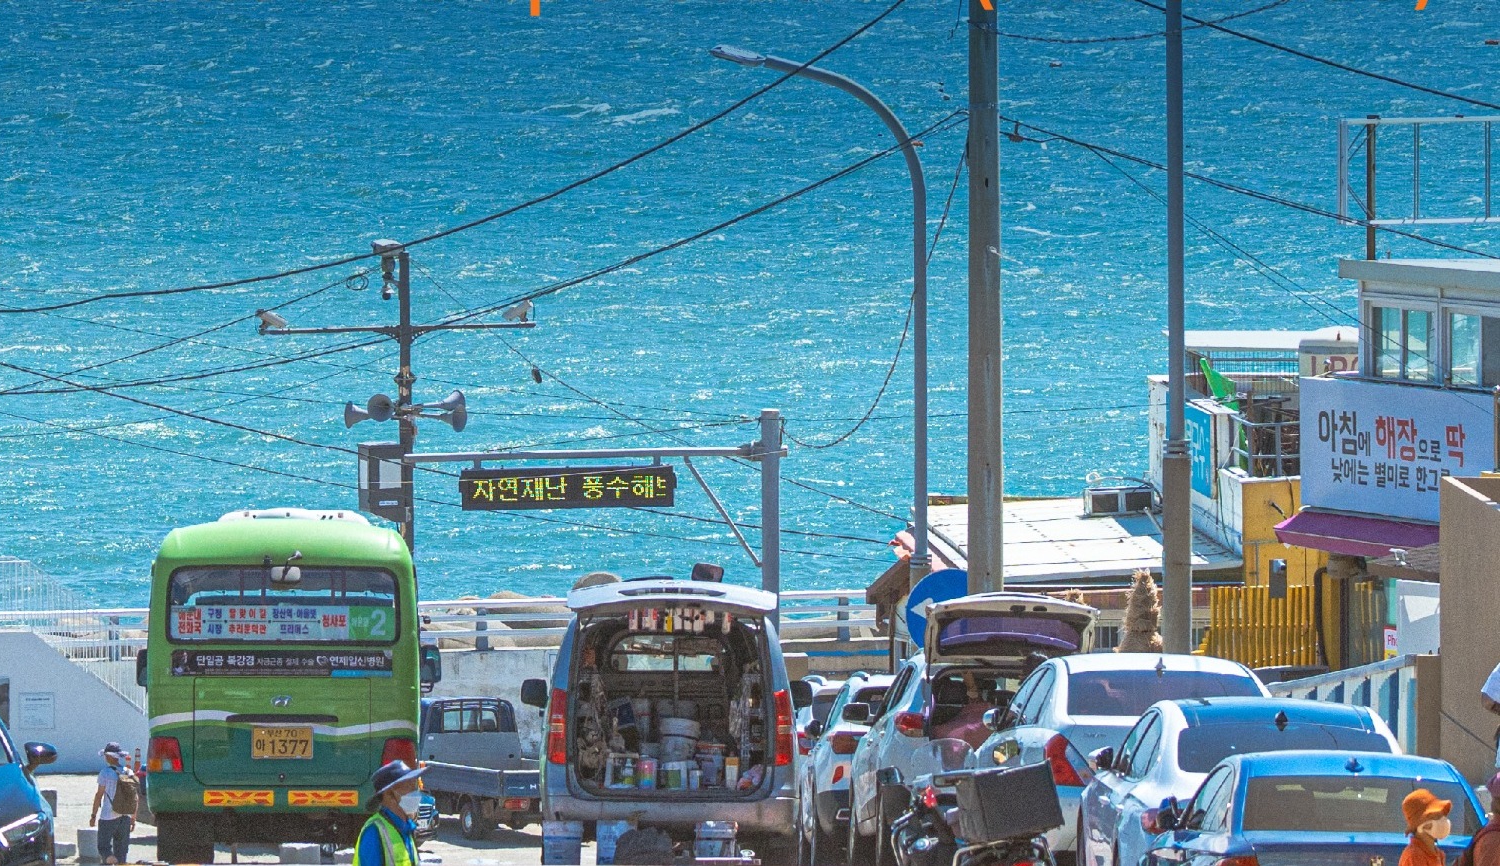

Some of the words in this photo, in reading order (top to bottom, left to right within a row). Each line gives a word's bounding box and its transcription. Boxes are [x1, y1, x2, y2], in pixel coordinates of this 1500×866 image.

[1318, 409, 1371, 457] 아침에
[1375, 415, 1442, 463] 해장으로
[1445, 423, 1466, 467] 딱
[473, 476, 567, 501] 자연재난
[1331, 457, 1369, 485] 낮에는
[1374, 462, 1410, 489] 별미로
[1415, 465, 1450, 492] 한그
[370, 609, 386, 636] 2
